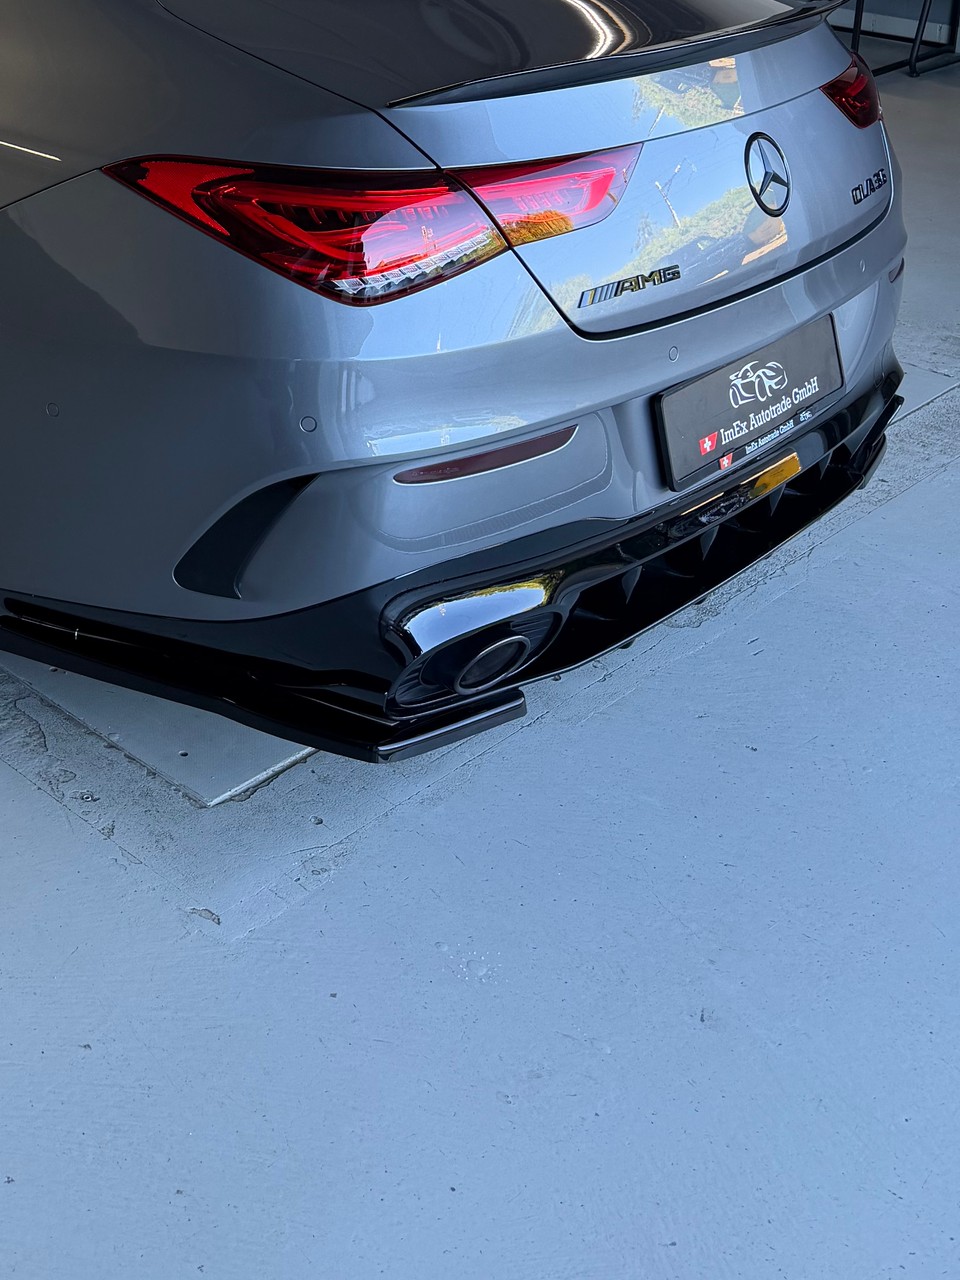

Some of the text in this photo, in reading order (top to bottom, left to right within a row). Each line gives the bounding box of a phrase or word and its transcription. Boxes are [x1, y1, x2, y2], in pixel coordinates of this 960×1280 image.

[614, 264, 681, 297] AMG
[720, 420, 749, 445] ImEx
[749, 395, 792, 430] Autotrade
[792, 376, 820, 404] GmbH
